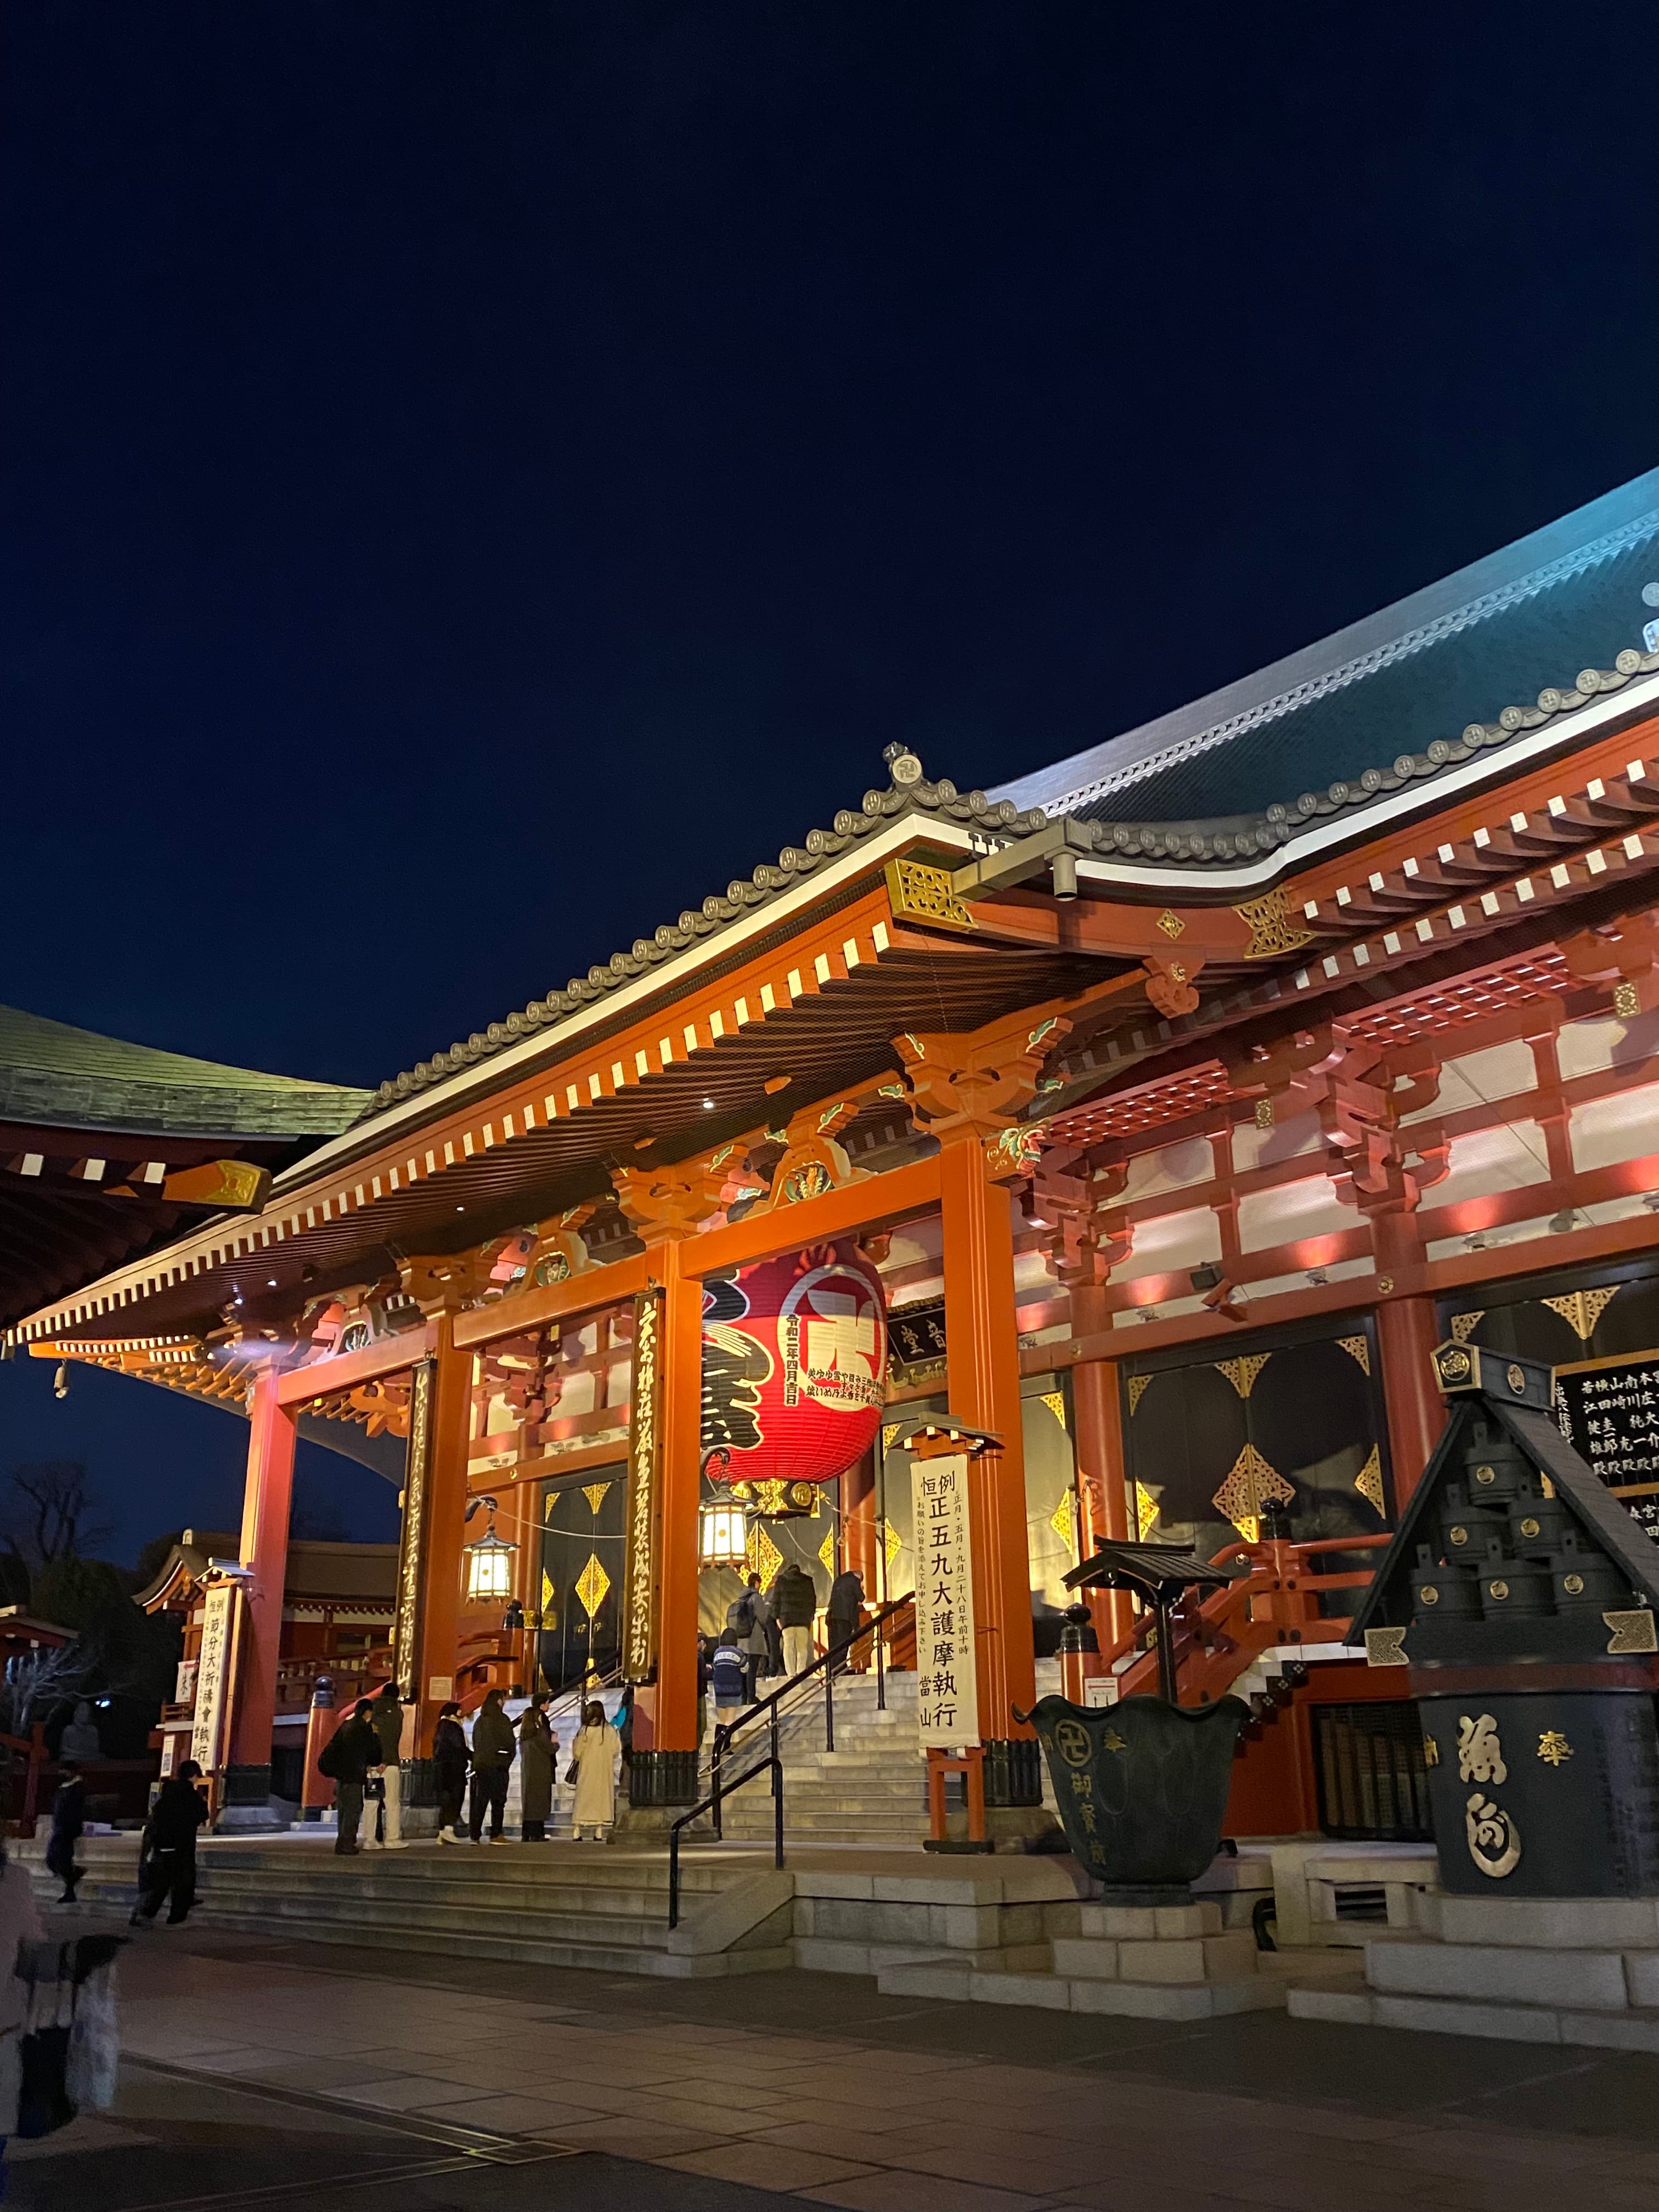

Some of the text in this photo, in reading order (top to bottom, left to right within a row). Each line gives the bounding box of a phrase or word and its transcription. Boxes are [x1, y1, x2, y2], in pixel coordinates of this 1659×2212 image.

[786, 1314, 799, 1405] 令和二年四月吉日
[921, 1470, 955, 1497] 恒例
